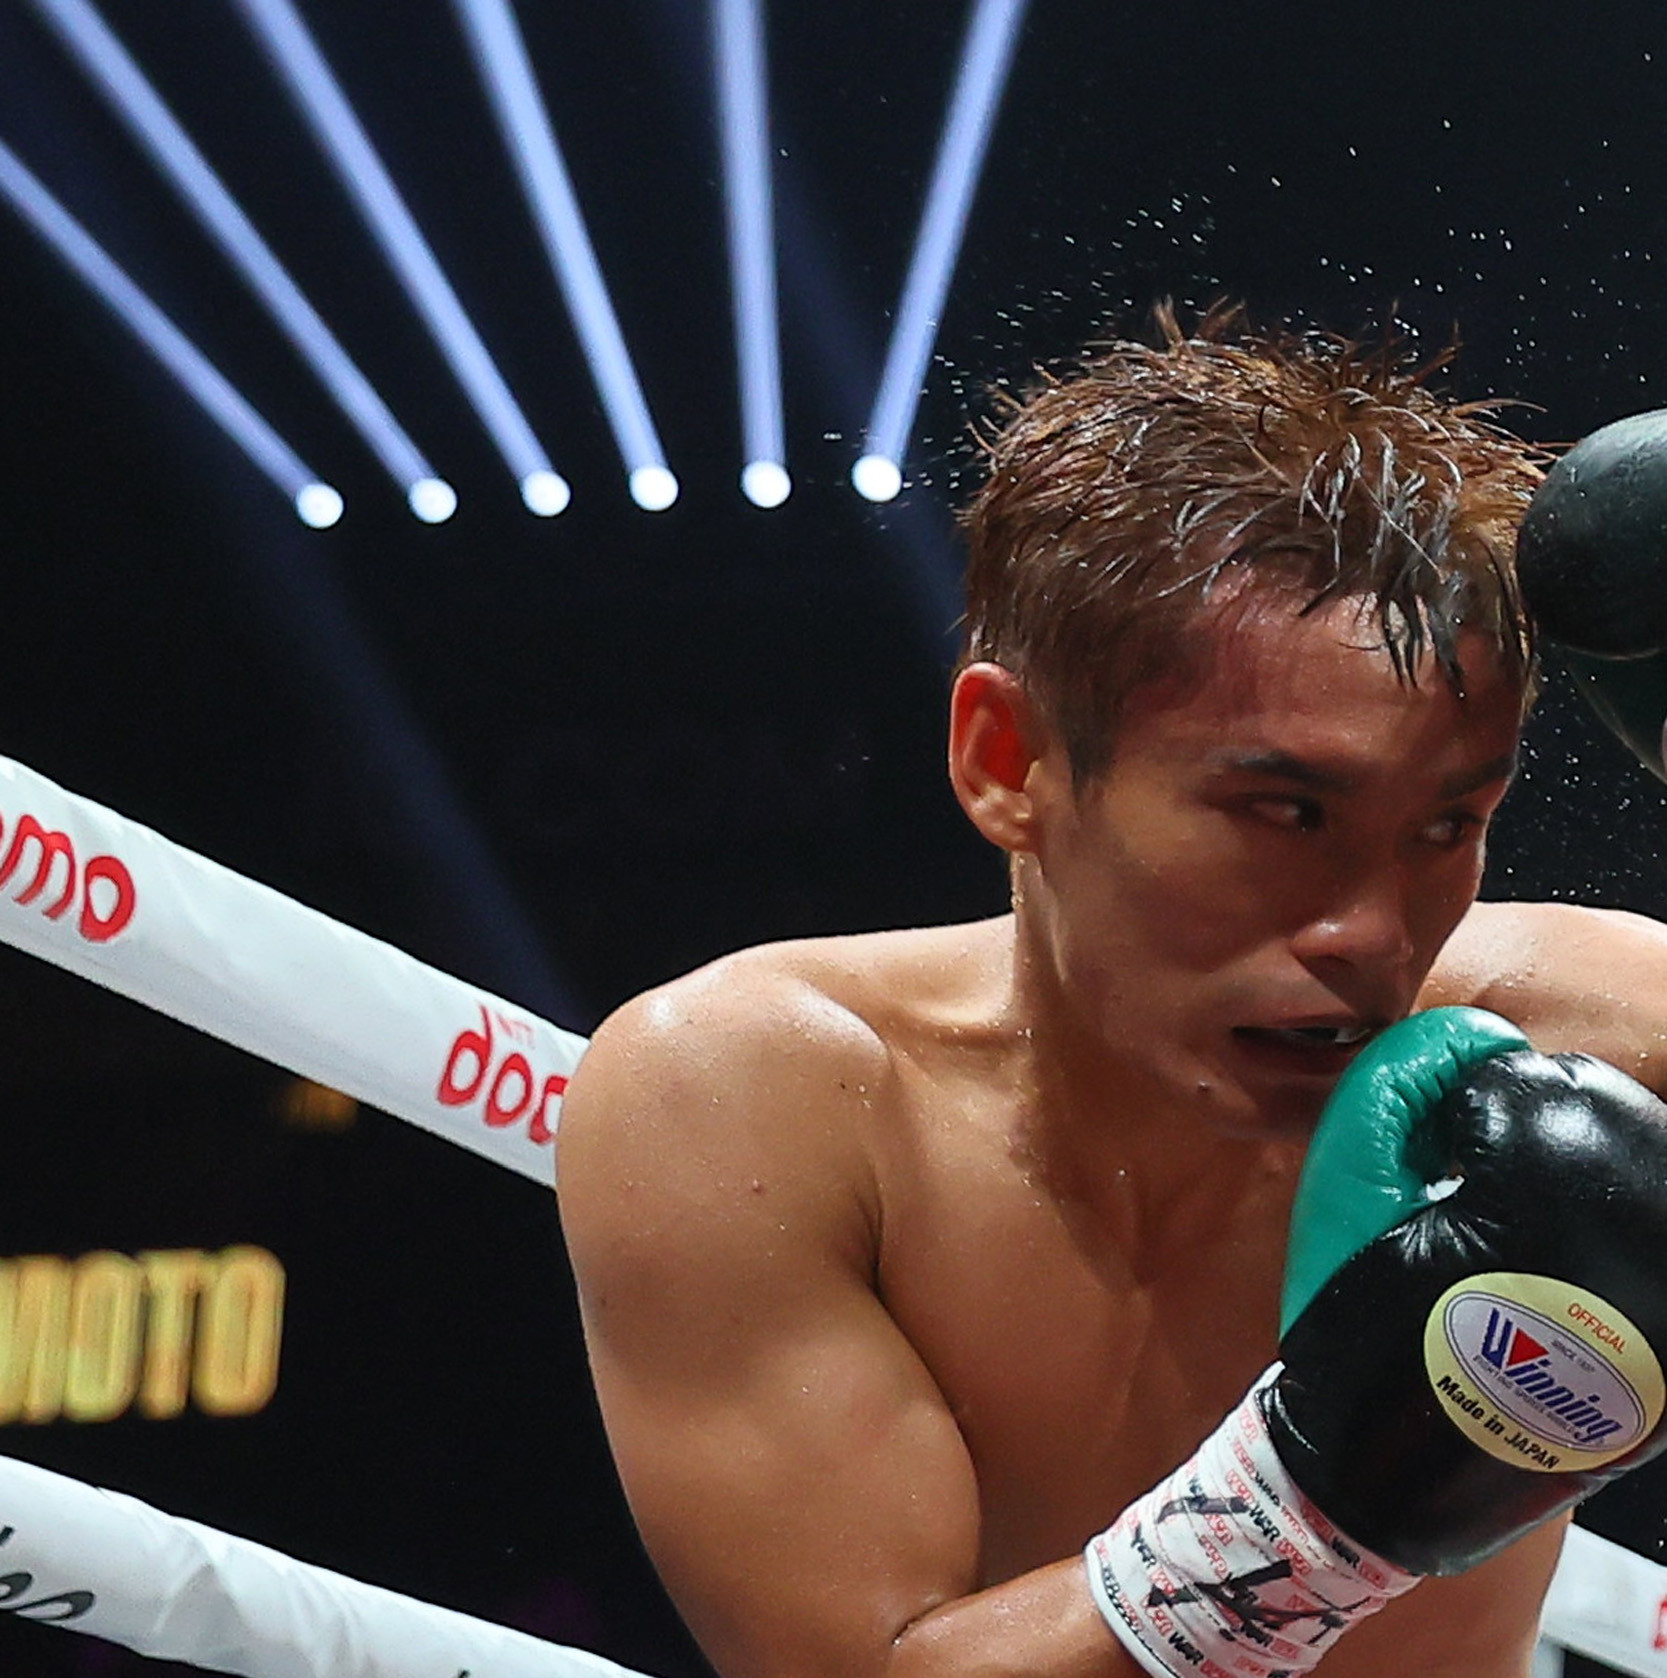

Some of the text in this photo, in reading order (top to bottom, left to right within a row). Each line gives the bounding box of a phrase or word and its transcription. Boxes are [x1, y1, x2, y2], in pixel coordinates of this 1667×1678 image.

[1480, 1306, 1624, 1444] Winning
[1565, 1302, 1627, 1355] OFFICIAL
[1435, 1374, 1561, 1470] Made in JAPAN
